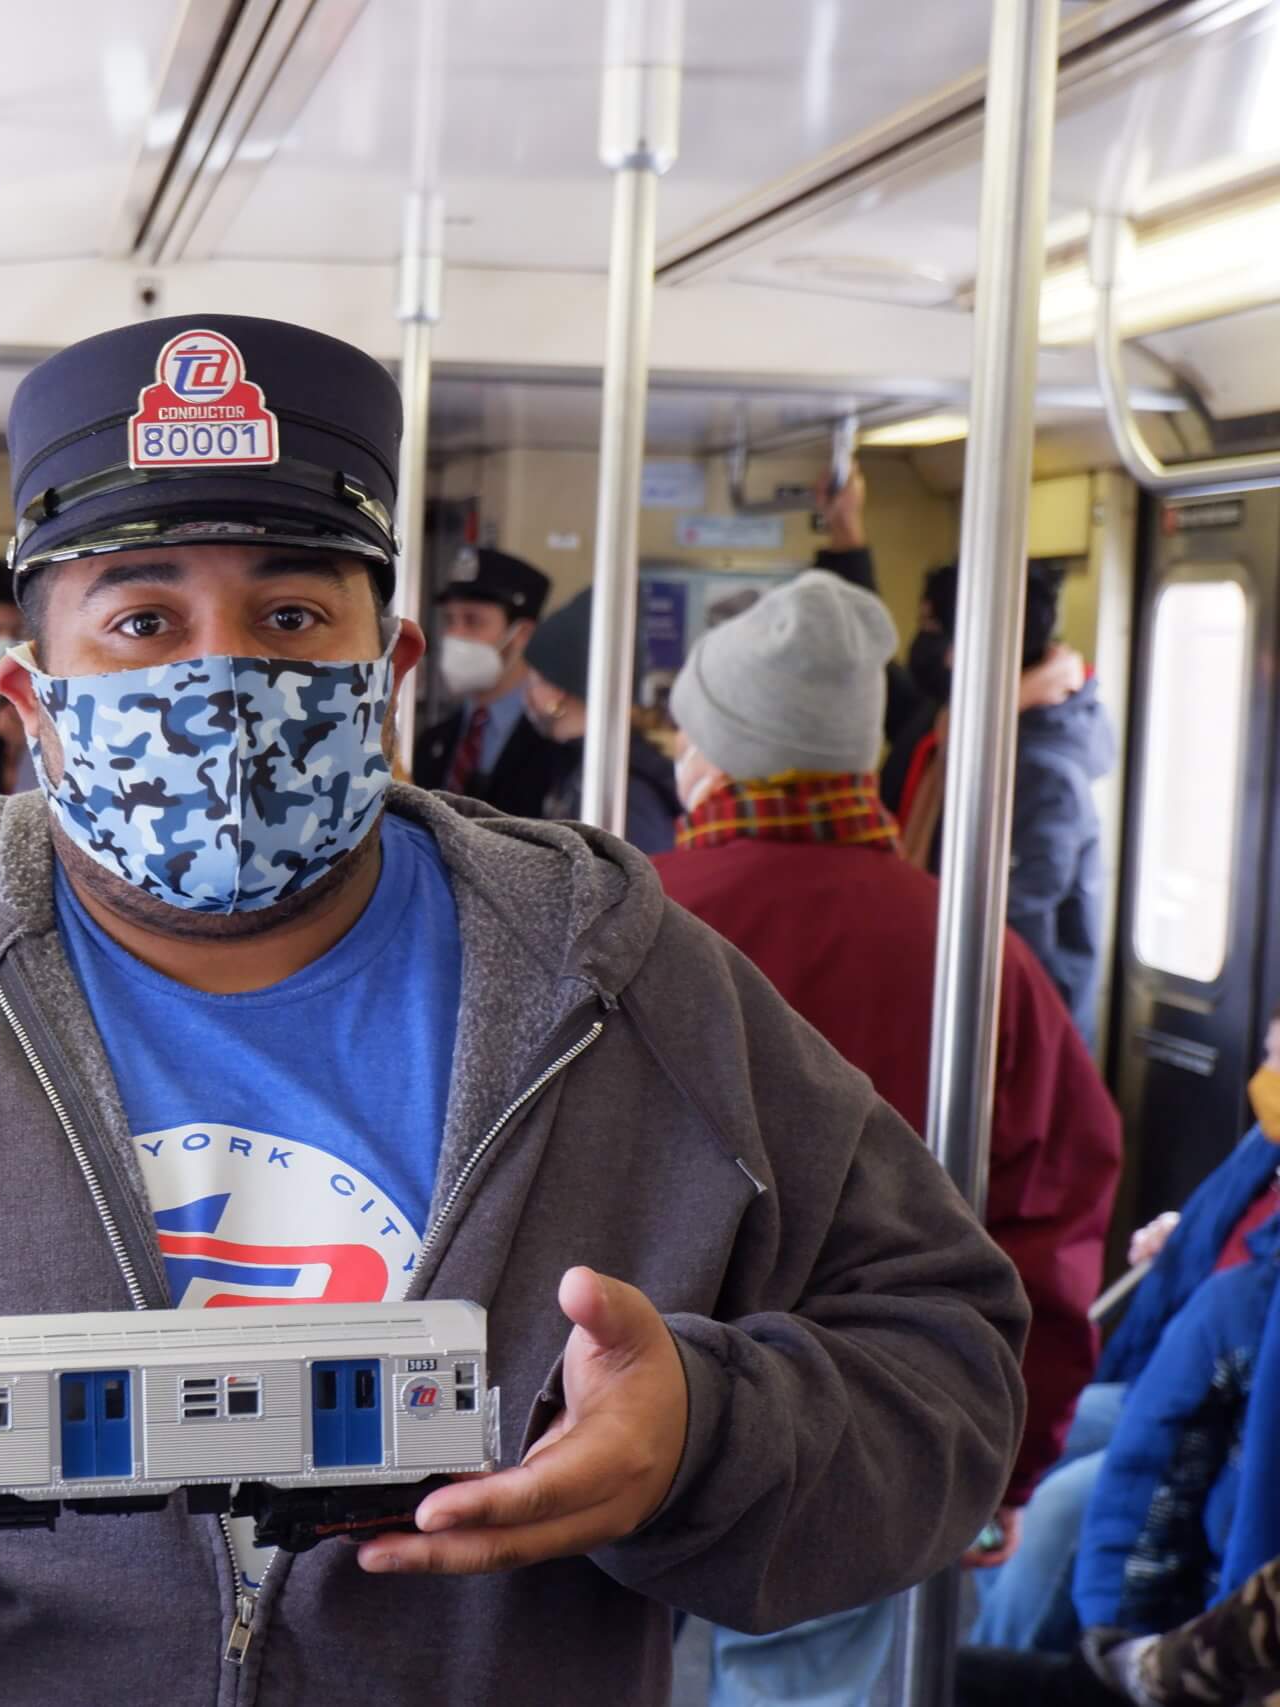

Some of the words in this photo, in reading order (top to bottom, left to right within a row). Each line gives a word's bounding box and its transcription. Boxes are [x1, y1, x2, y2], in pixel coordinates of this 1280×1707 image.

[158, 405, 246, 421] CONDUCTOR
[143, 424, 257, 457] 80001
[140, 1132, 294, 1169] YORK
[409, 1360, 435, 1370] 3053
